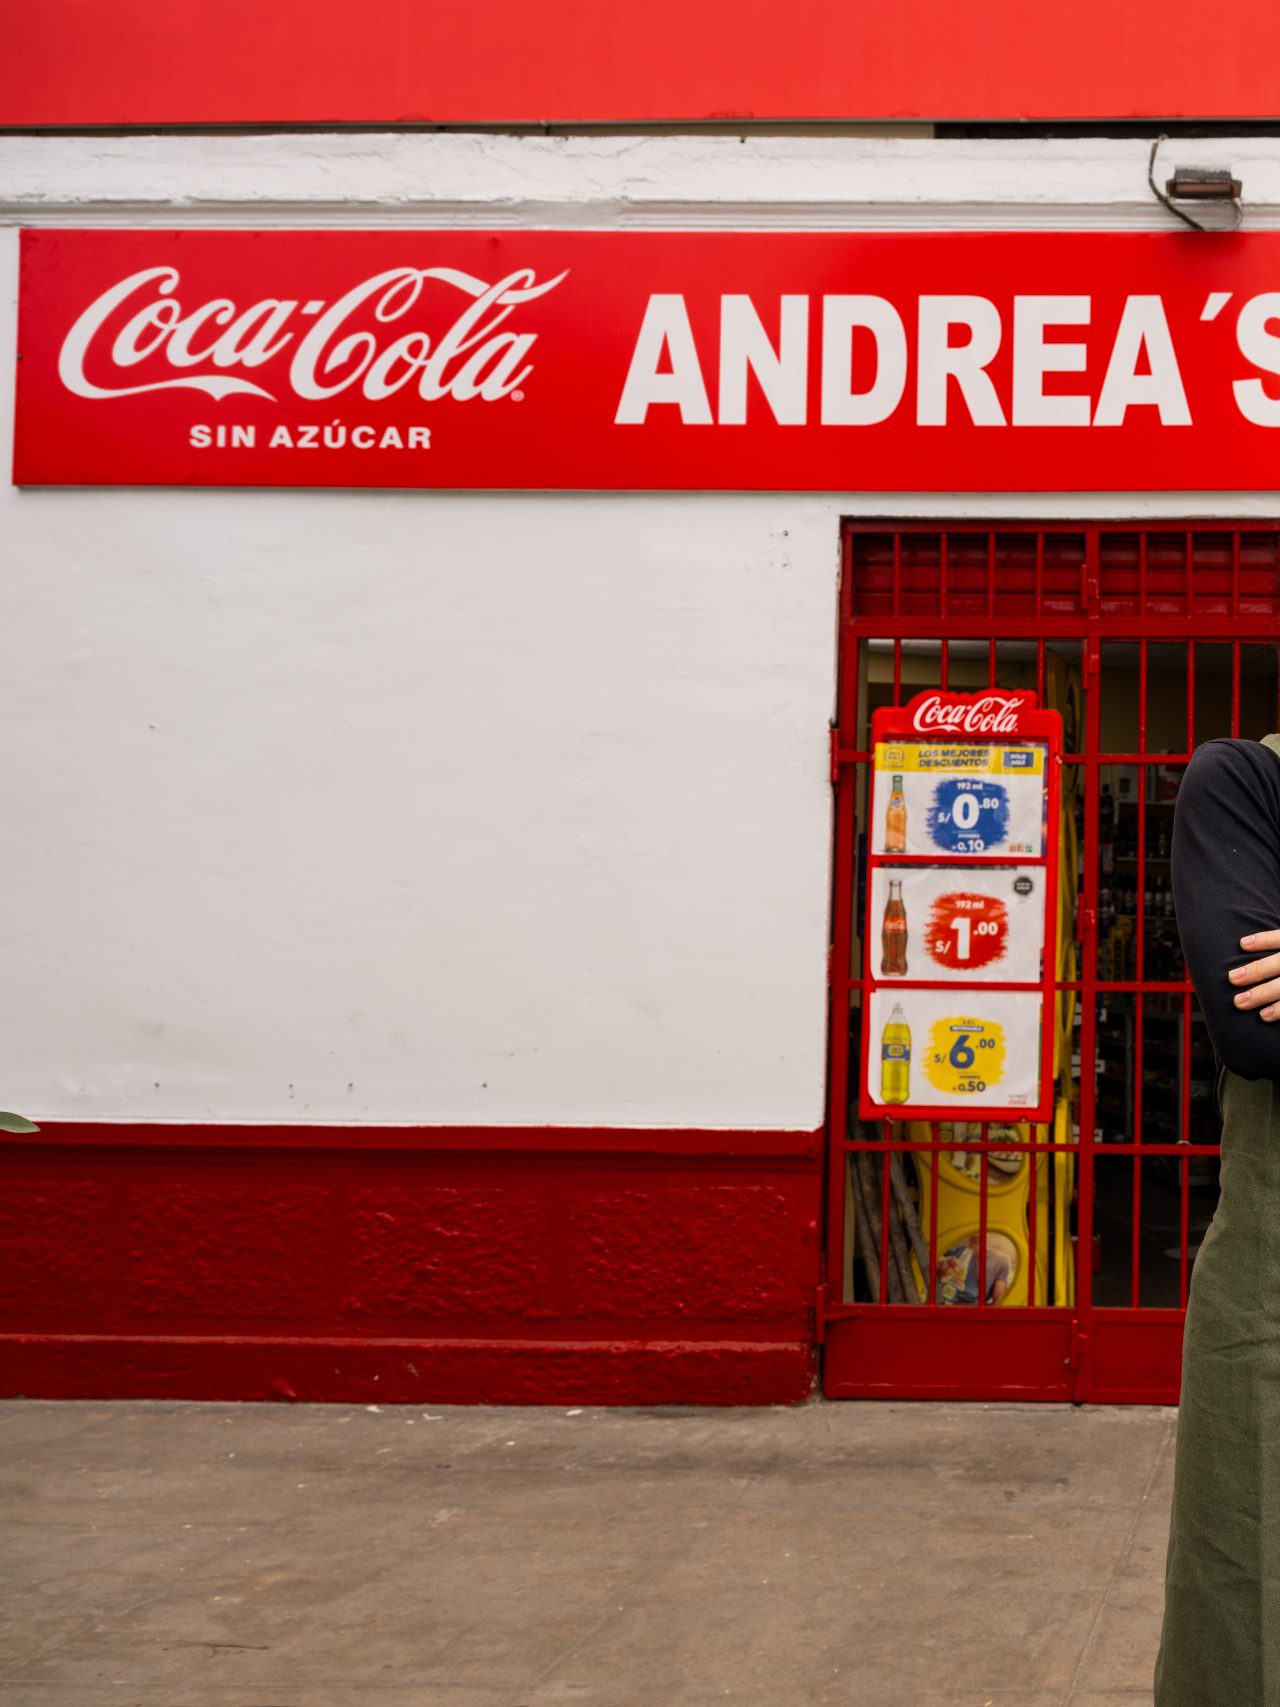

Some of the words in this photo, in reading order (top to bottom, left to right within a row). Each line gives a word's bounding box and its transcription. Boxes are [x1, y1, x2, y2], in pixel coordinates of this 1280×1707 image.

[58, 266, 570, 402] Coca-Cola
[189, 424, 256, 449] SIN
[269, 419, 432, 449] AZÚCAR
[913, 696, 1025, 732] Coca-Cola
[918, 749, 940, 758] LOS
[941, 749, 990, 758] MEJORES
[919, 758, 988, 768] DESCUENTOS
[938, 812, 951, 824] S/
[955, 900, 971, 909] 192
[973, 900, 984, 909] ml
[935, 941, 951, 954] S/
[934, 1054, 946, 1064] S/
